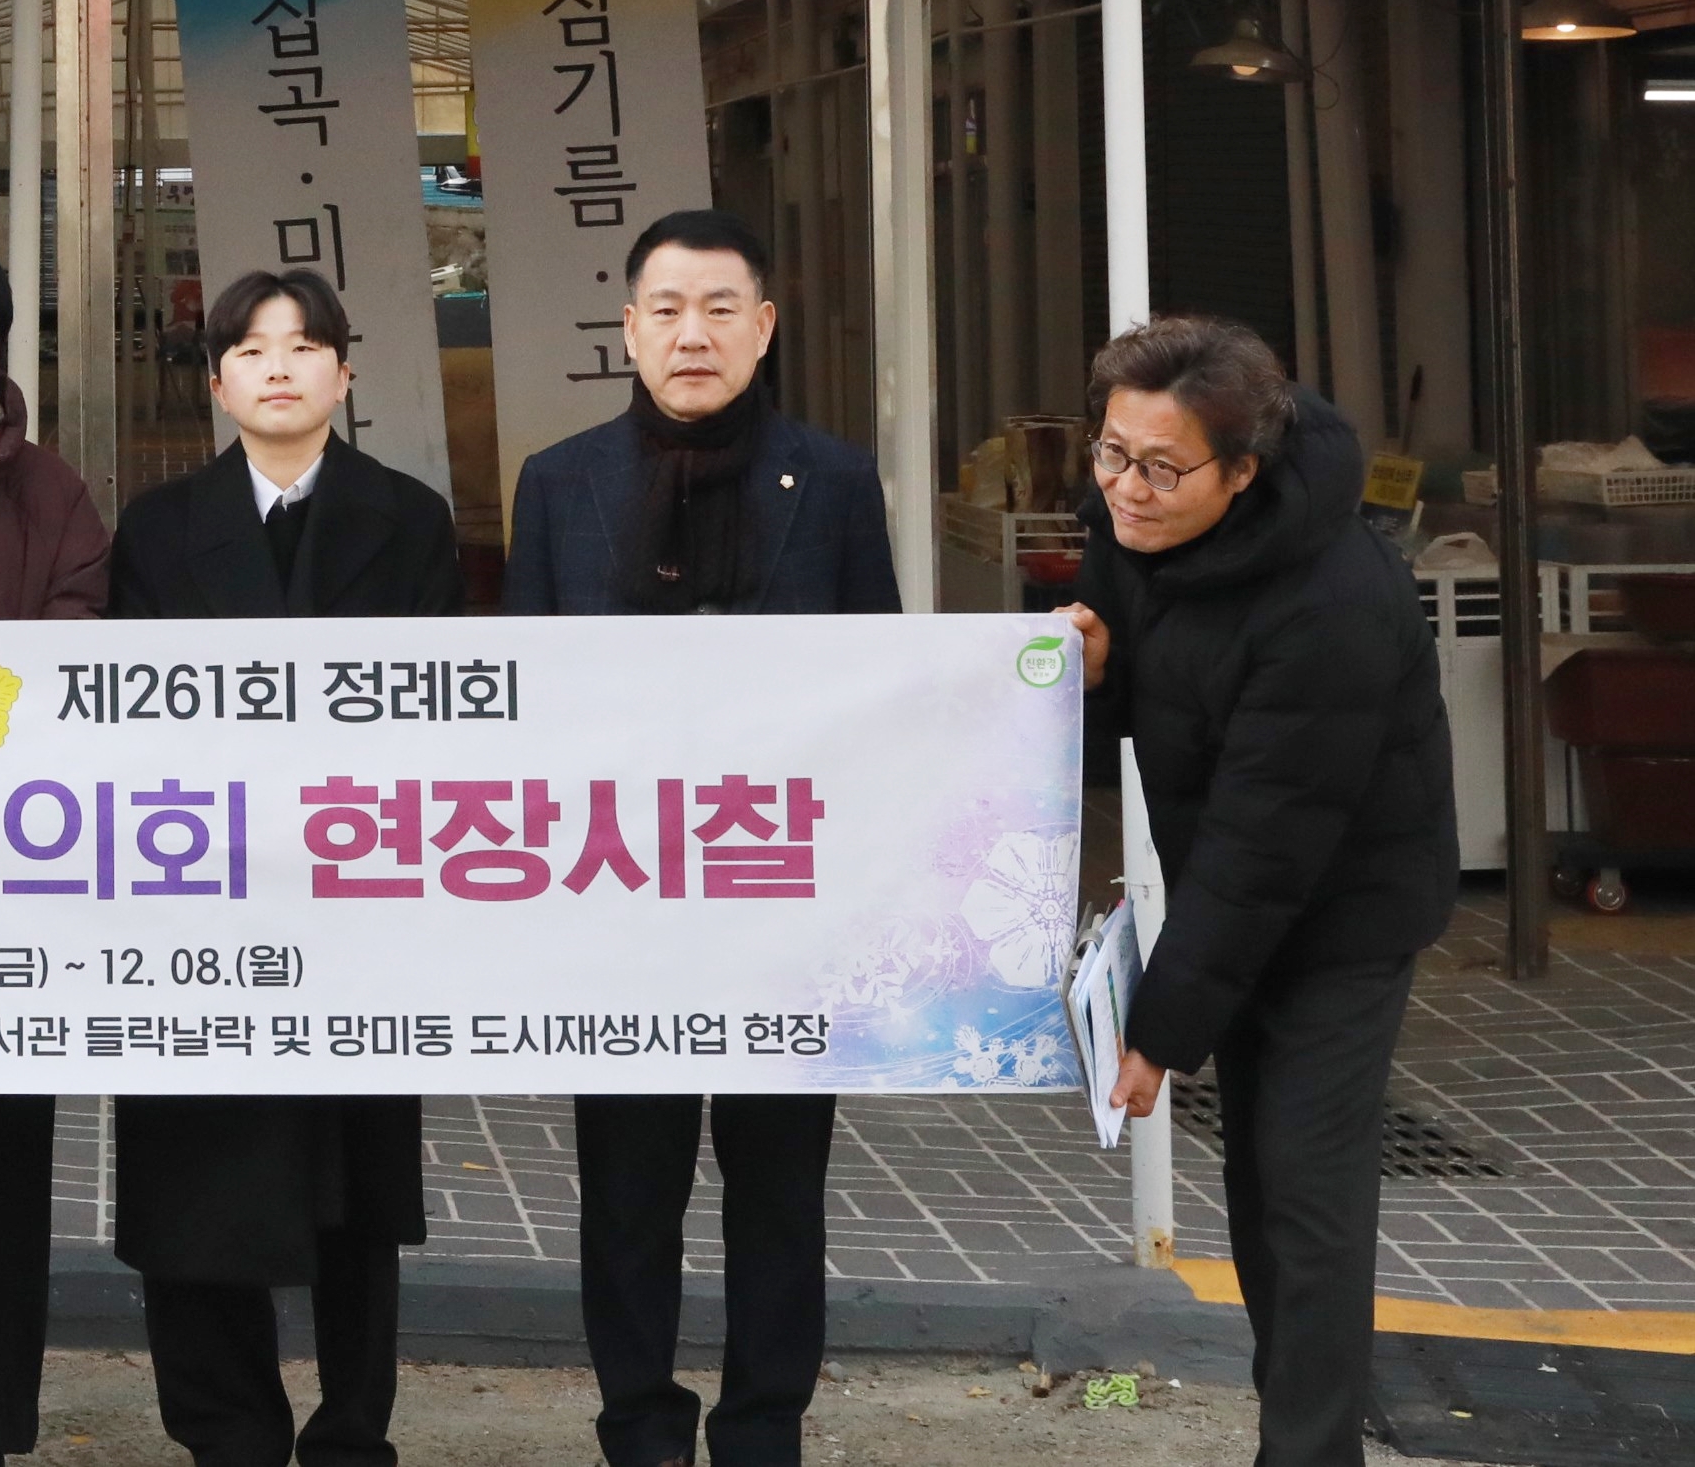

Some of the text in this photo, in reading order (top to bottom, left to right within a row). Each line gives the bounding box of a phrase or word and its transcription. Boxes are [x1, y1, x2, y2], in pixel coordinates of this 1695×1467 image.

[1025, 657, 1056, 670] 친환경
[57, 658, 519, 724] 제261회 정례회
[299, 774, 825, 902] 현장시찰
[100, 947, 155, 987] 12.
[170, 944, 304, 989] 08.(월)
[84, 1014, 256, 1058] 들락날락
[271, 1014, 313, 1058] 및
[327, 1014, 454, 1058] 망미동
[470, 1012, 727, 1057] 도시재생사업
[742, 1012, 830, 1057] 현장
